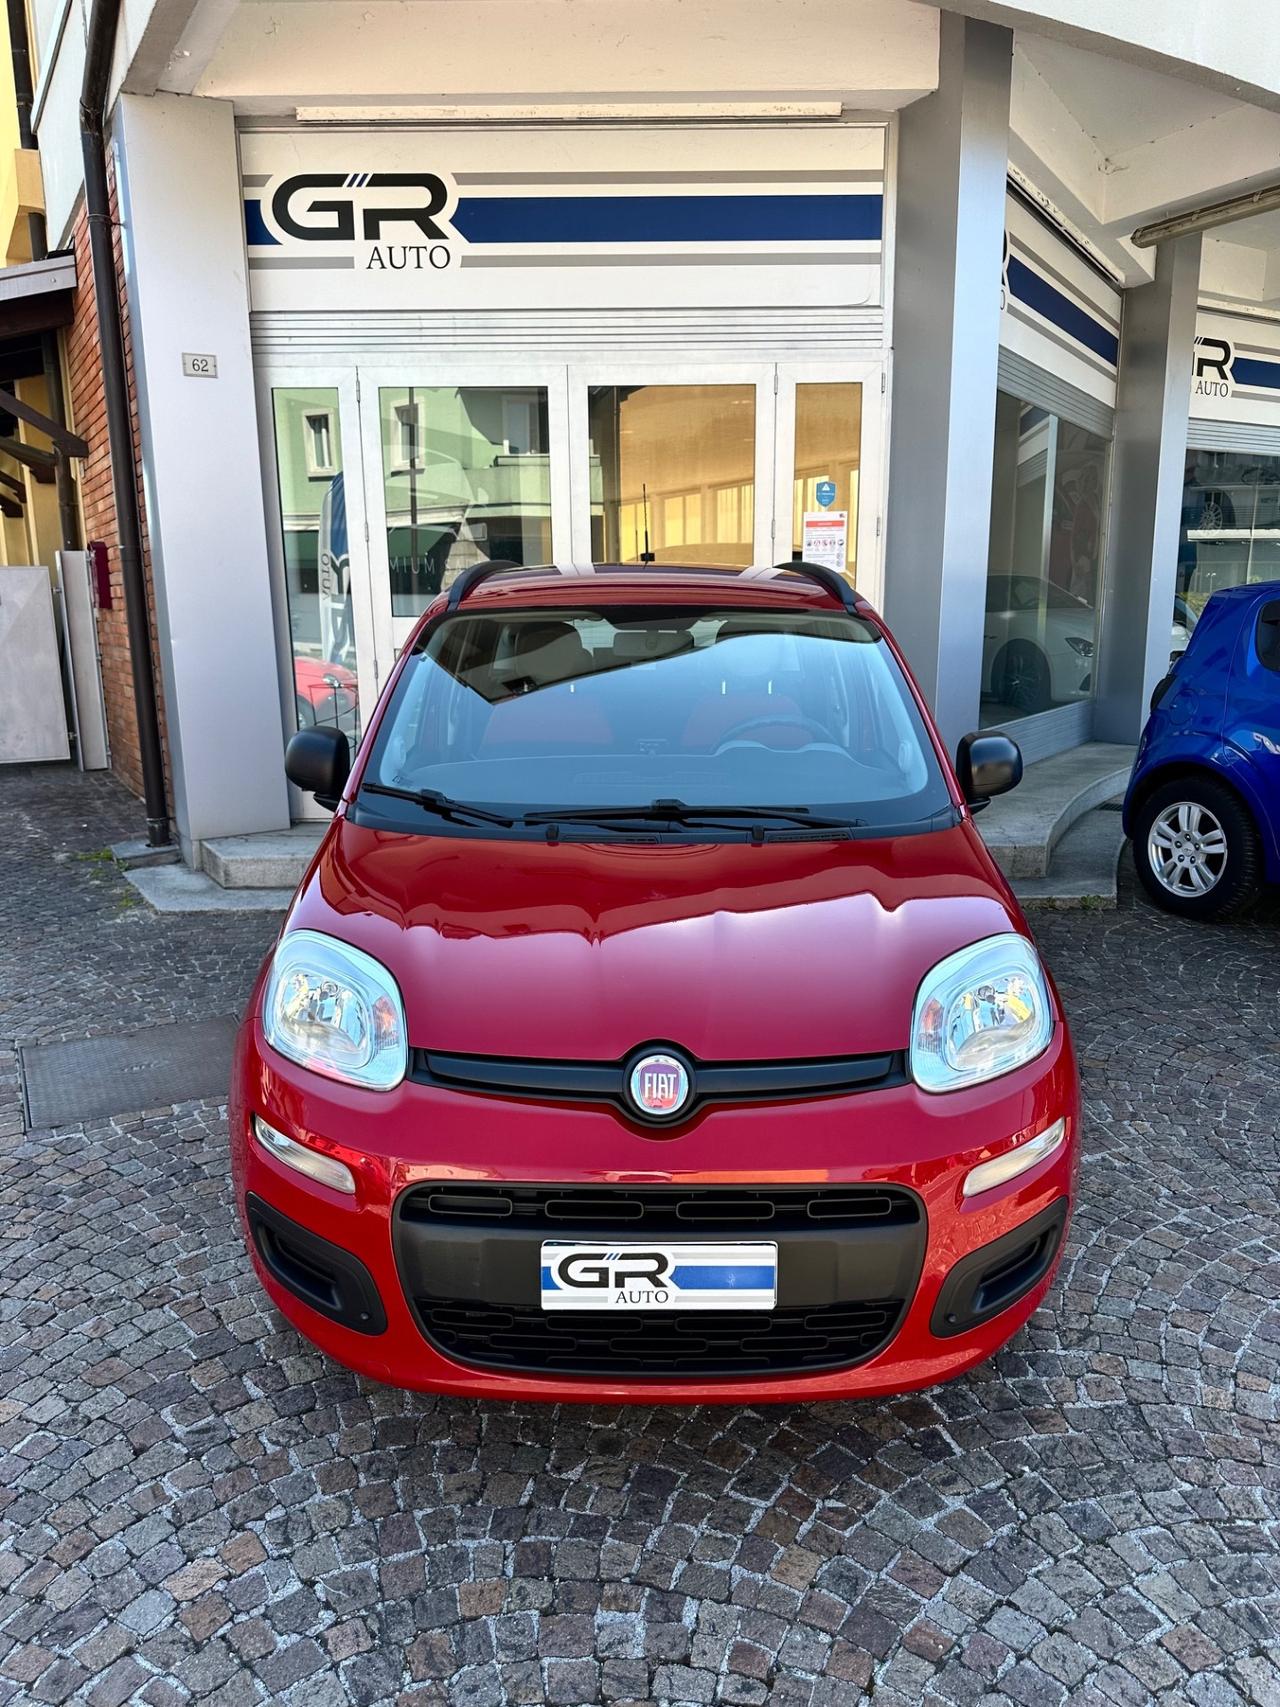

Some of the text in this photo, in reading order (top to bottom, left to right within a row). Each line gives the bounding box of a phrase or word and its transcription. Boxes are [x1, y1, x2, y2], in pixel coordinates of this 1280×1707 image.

[272, 173, 449, 240] GR
[366, 245, 451, 269] AUTO
[192, 358, 209, 373] 62
[1192, 336, 1231, 380] R
[1195, 380, 1230, 398] AUTO
[645, 1073, 677, 1099] FIAT
[558, 1252, 668, 1288] GR
[615, 1290, 669, 1304] AUTO
